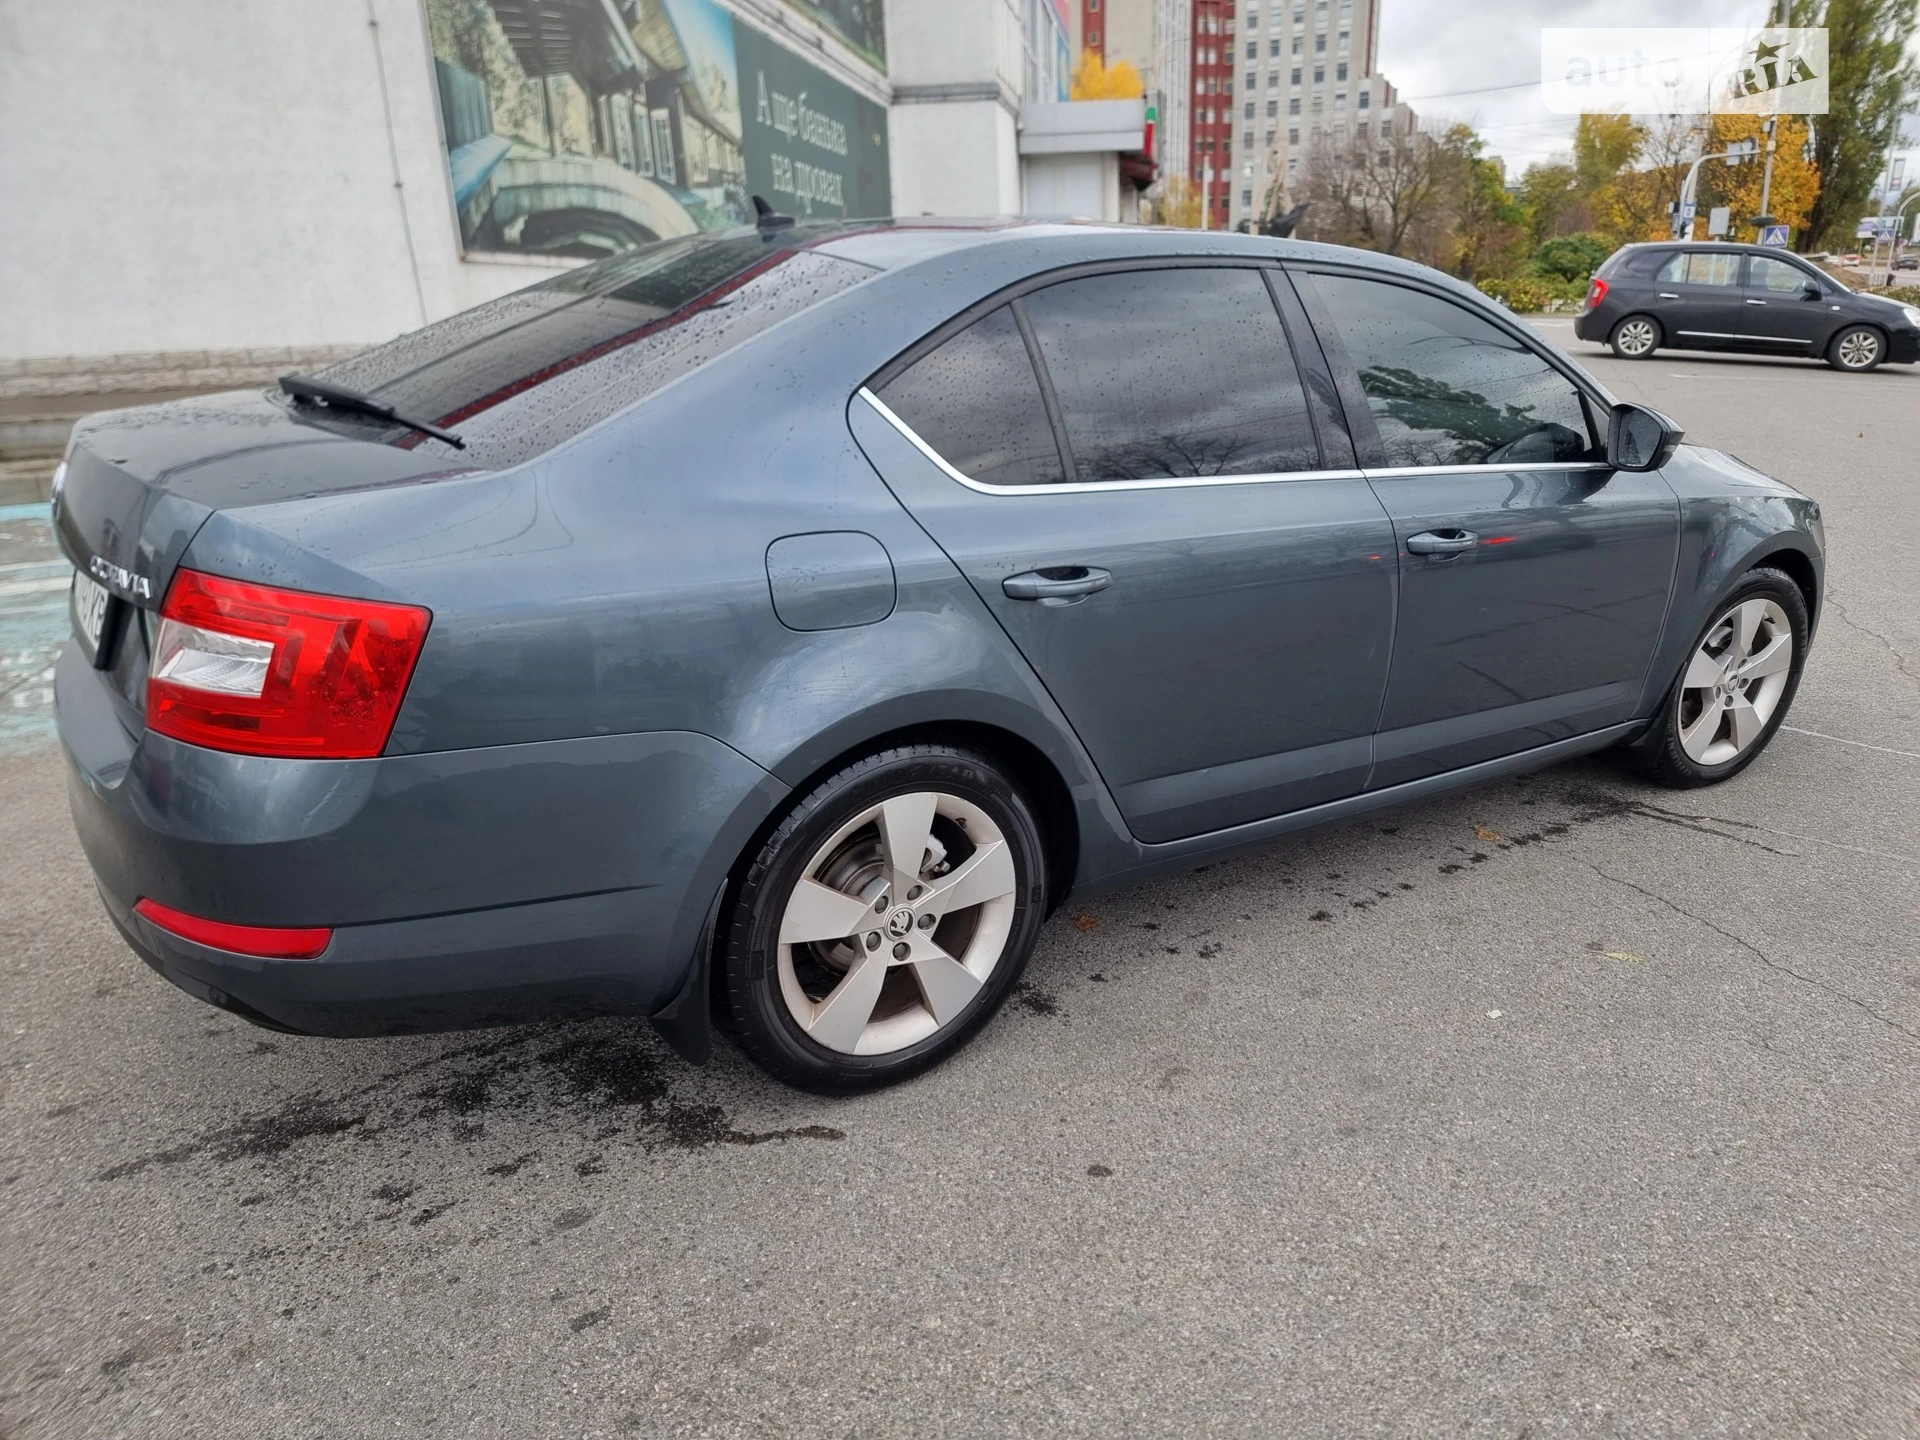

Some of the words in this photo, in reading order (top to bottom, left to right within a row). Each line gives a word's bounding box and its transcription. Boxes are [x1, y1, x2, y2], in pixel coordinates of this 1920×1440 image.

[756, 70, 773, 126] А
[771, 91, 799, 144] ще
[770, 152, 795, 195] на
[793, 160, 845, 215] дровах
